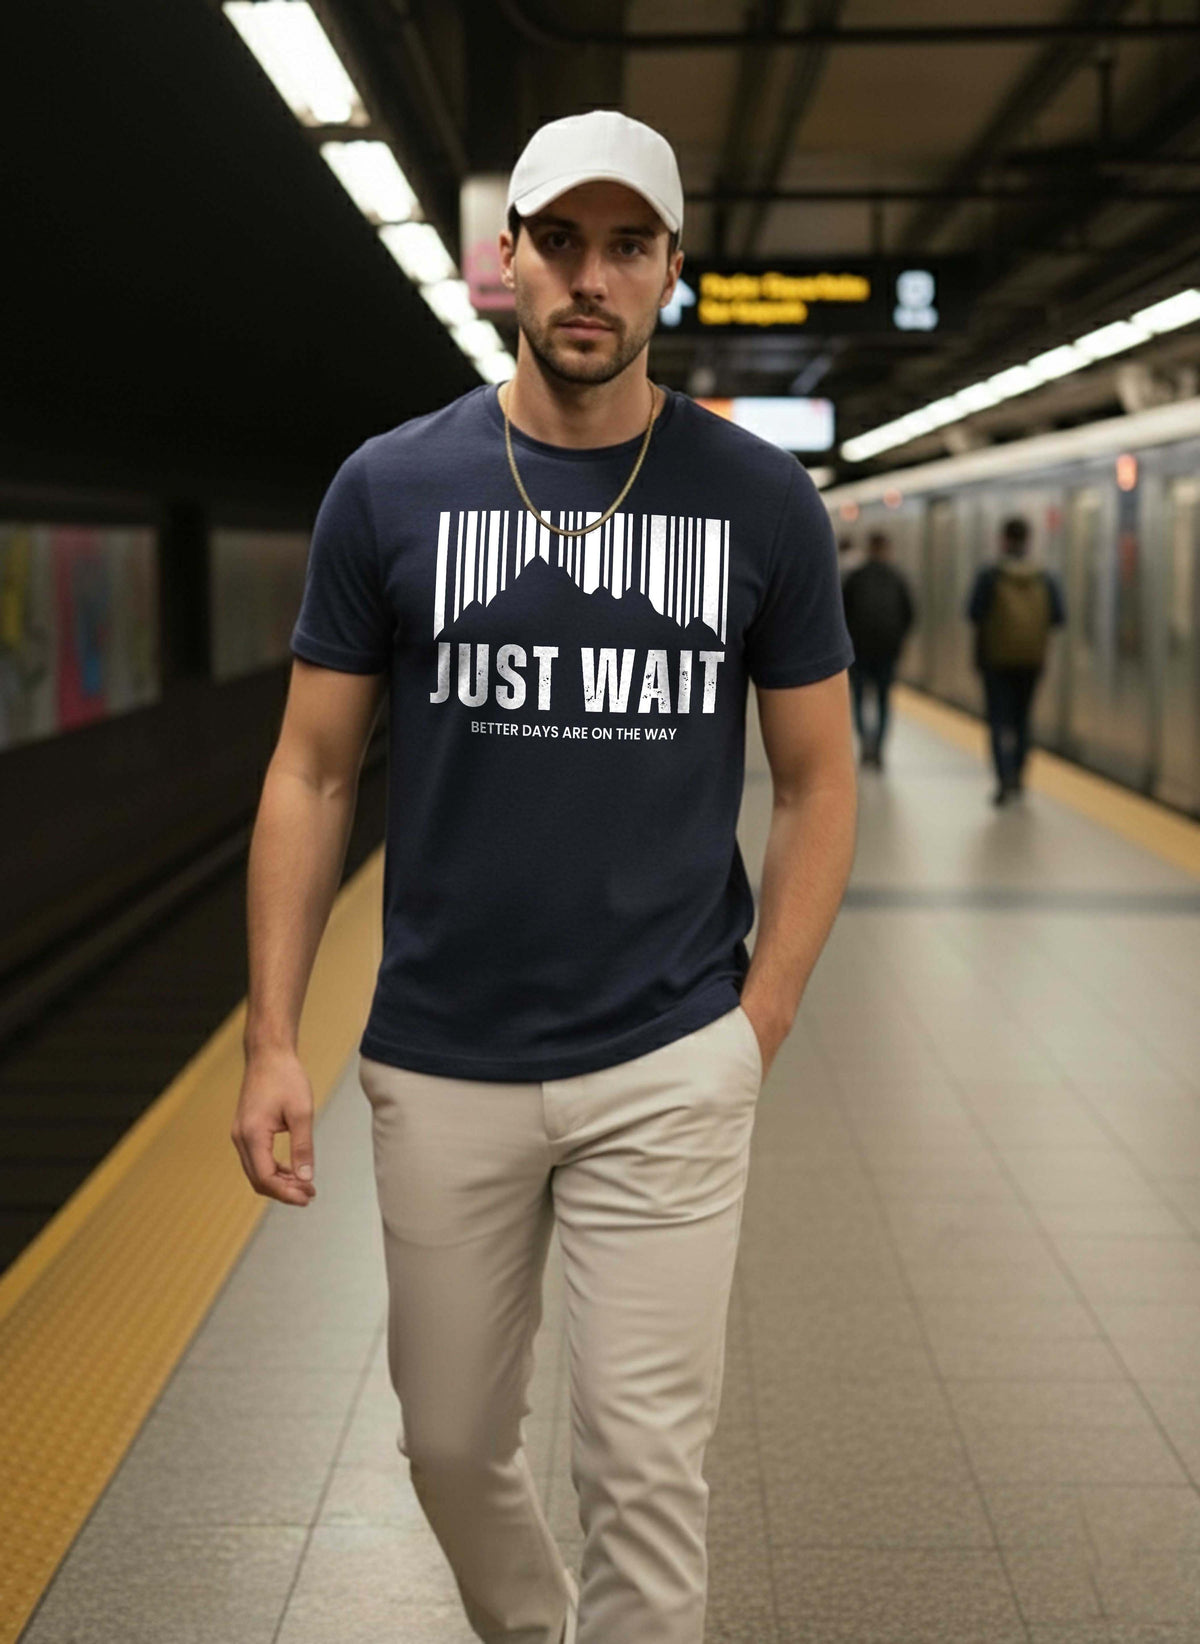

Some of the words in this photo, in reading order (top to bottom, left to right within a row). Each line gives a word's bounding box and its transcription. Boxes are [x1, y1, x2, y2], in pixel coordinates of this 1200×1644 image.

[429, 642, 559, 710] JUST
[580, 647, 726, 714] WAIT
[471, 721, 519, 736] BETTER
[522, 724, 559, 739] DAYS
[562, 726, 588, 740] ARE
[591, 727, 613, 740] ON
[616, 728, 641, 740] THE
[644, 728, 677, 741] WAY
